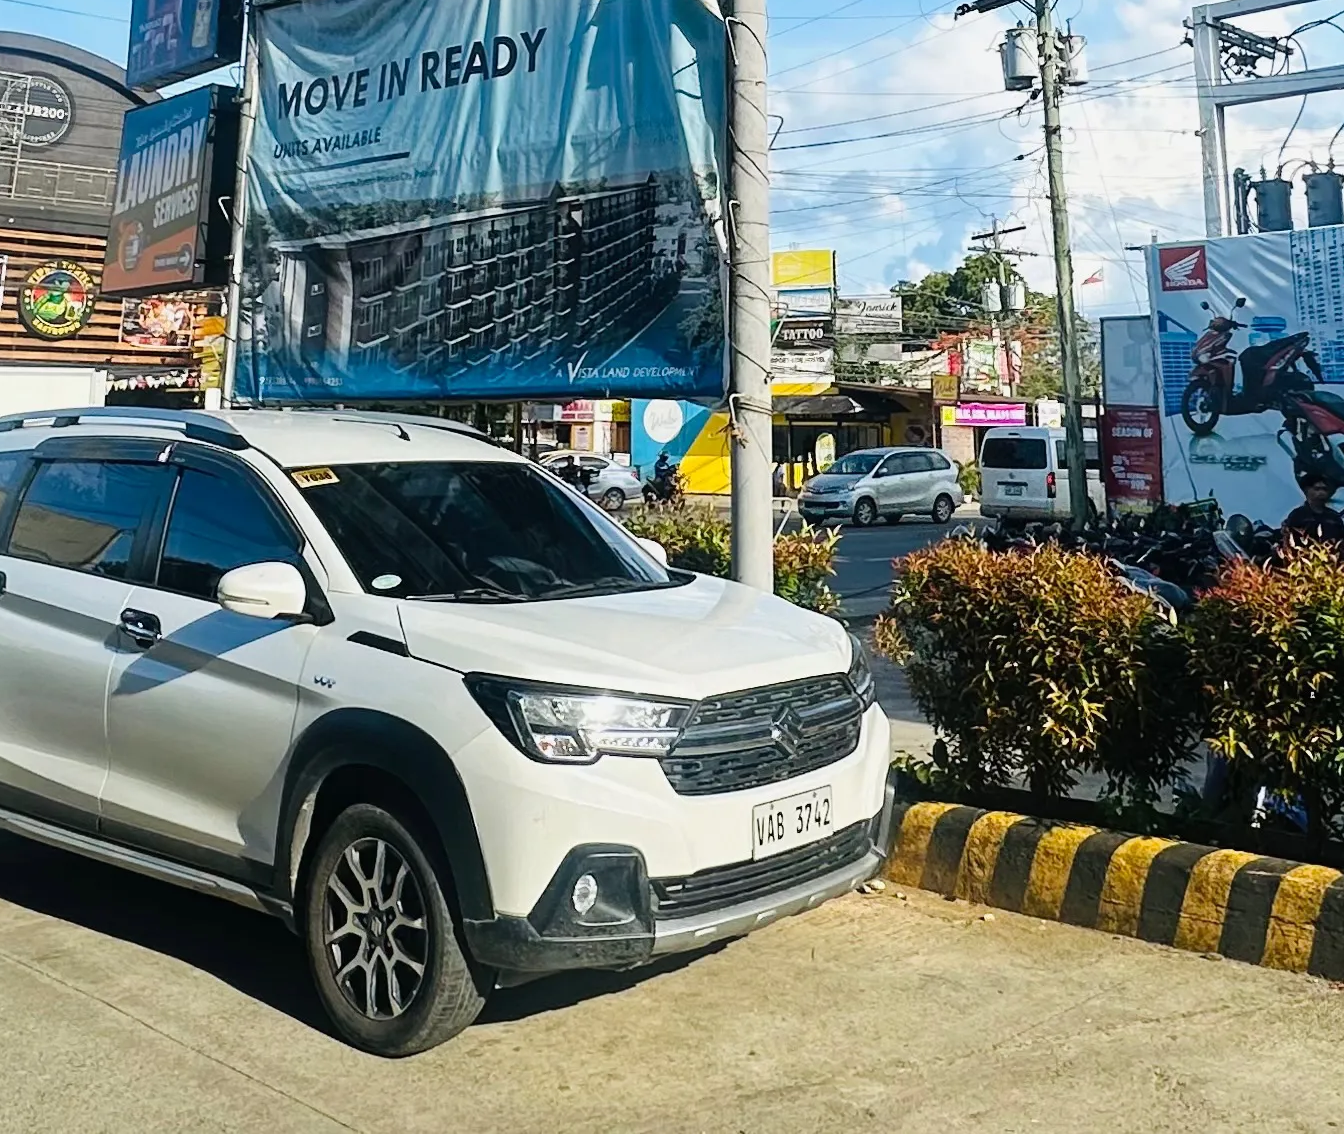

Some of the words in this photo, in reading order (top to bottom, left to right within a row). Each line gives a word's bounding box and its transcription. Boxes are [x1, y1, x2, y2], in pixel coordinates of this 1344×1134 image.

[278, 68, 370, 120] MOVE
[377, 57, 412, 103] IN
[420, 27, 547, 93] READY
[273, 138, 308, 160] UNITS
[311, 126, 382, 156] AVAILABLE
[115, 117, 206, 216] LAUNDRY
[152, 183, 199, 229] SERVICES
[1166, 278, 1205, 288] HONDA
[782, 327, 824, 341] TATTOO
[567, 350, 599, 385] VISTA
[602, 366, 630, 379] LAND
[632, 365, 700, 378] DEVELOPMENT
[756, 811, 785, 846] VAB
[796, 798, 831, 834] 3742
